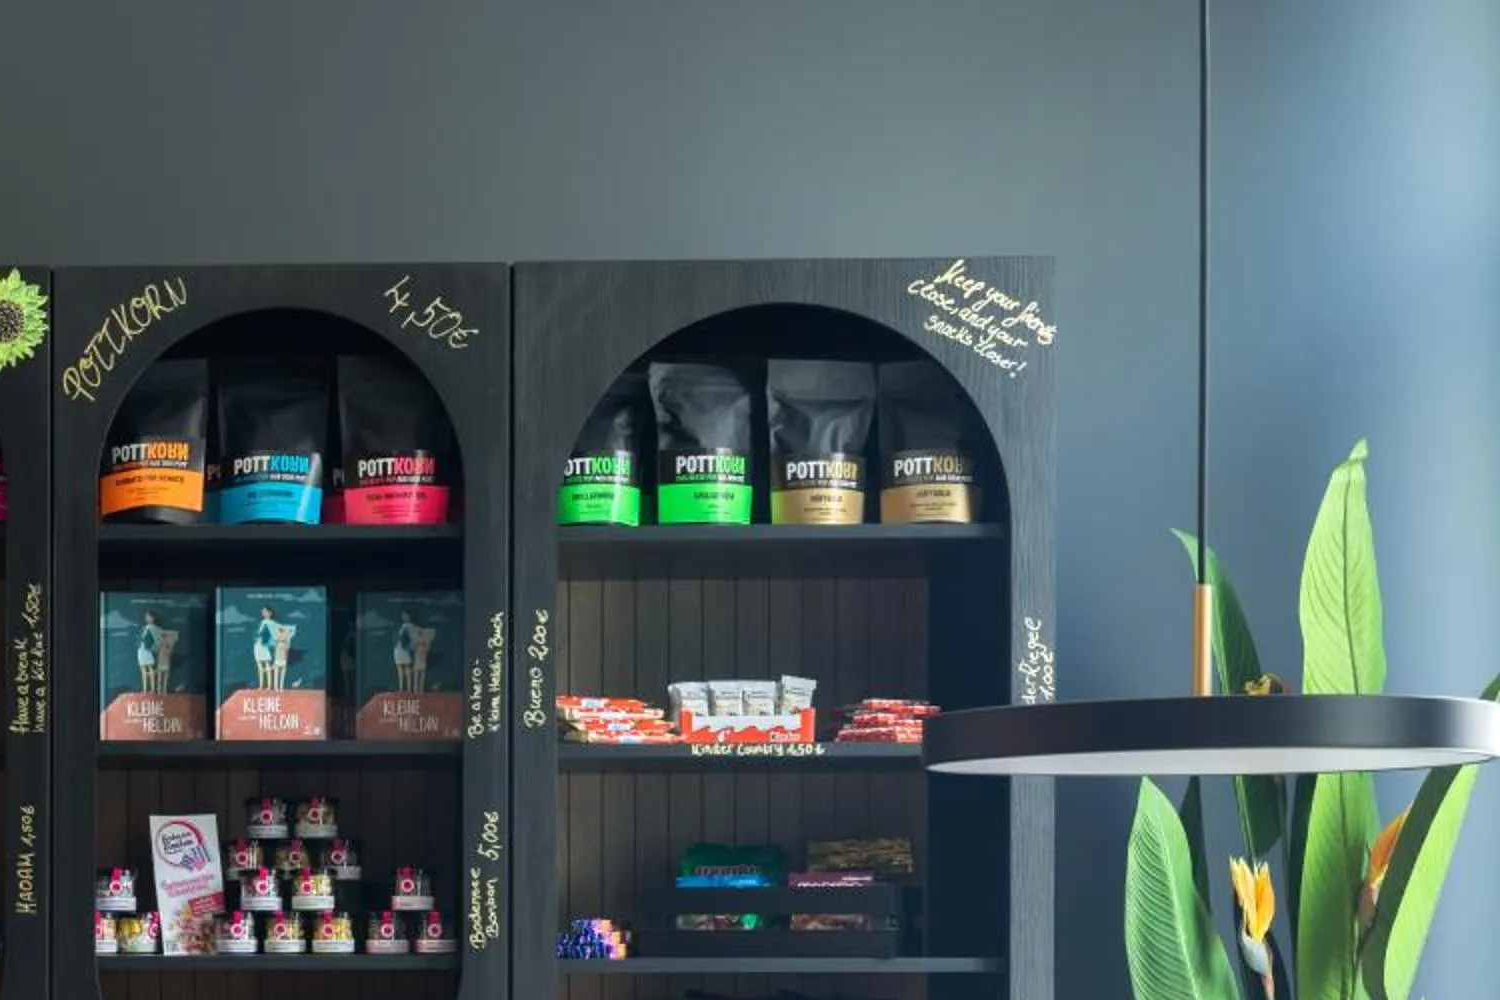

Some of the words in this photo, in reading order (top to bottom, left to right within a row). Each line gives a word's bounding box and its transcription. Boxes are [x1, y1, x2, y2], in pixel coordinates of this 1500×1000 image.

[933, 259, 985, 299] Keep
[971, 287, 1021, 312] your
[958, 307, 995, 330] and
[62, 276, 188, 401] POTTKORN
[111, 441, 190, 464] POTTKORN
[357, 456, 436, 478] POTTKORN
[563, 455, 632, 476] OTTKORN
[522, 666, 547, 738] Bueno
